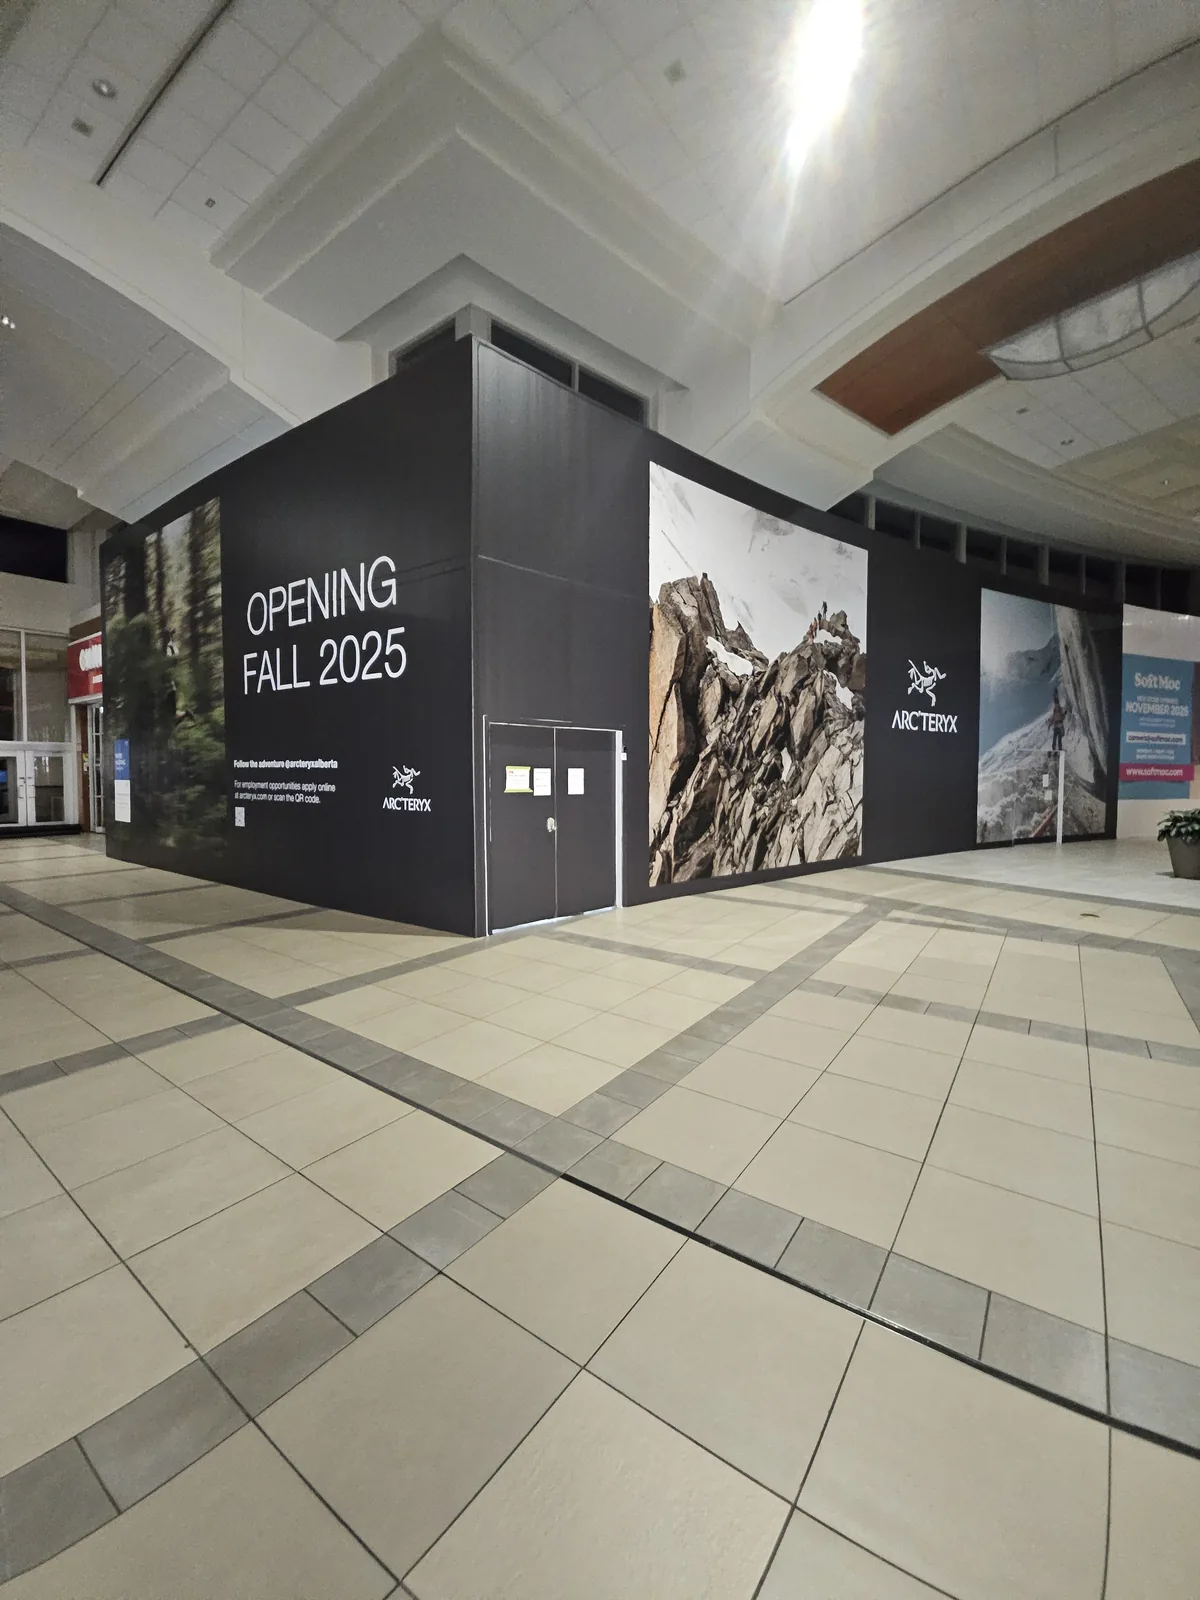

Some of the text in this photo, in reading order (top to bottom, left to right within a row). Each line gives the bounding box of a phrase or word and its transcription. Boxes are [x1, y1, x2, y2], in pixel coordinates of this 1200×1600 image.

[247, 555, 397, 636] OPENING
[243, 626, 407, 695] FALL 2025
[233, 758, 338, 770] Follow the adventure @arcteryxalberta
[241, 780, 268, 790] employment
[268, 782, 301, 790] opportunities
[301, 782, 317, 793] apply
[317, 782, 336, 792] online
[273, 793, 286, 802] scan
[286, 793, 295, 802] the
[295, 794, 304, 803] QR
[304, 795, 321, 803] code.
